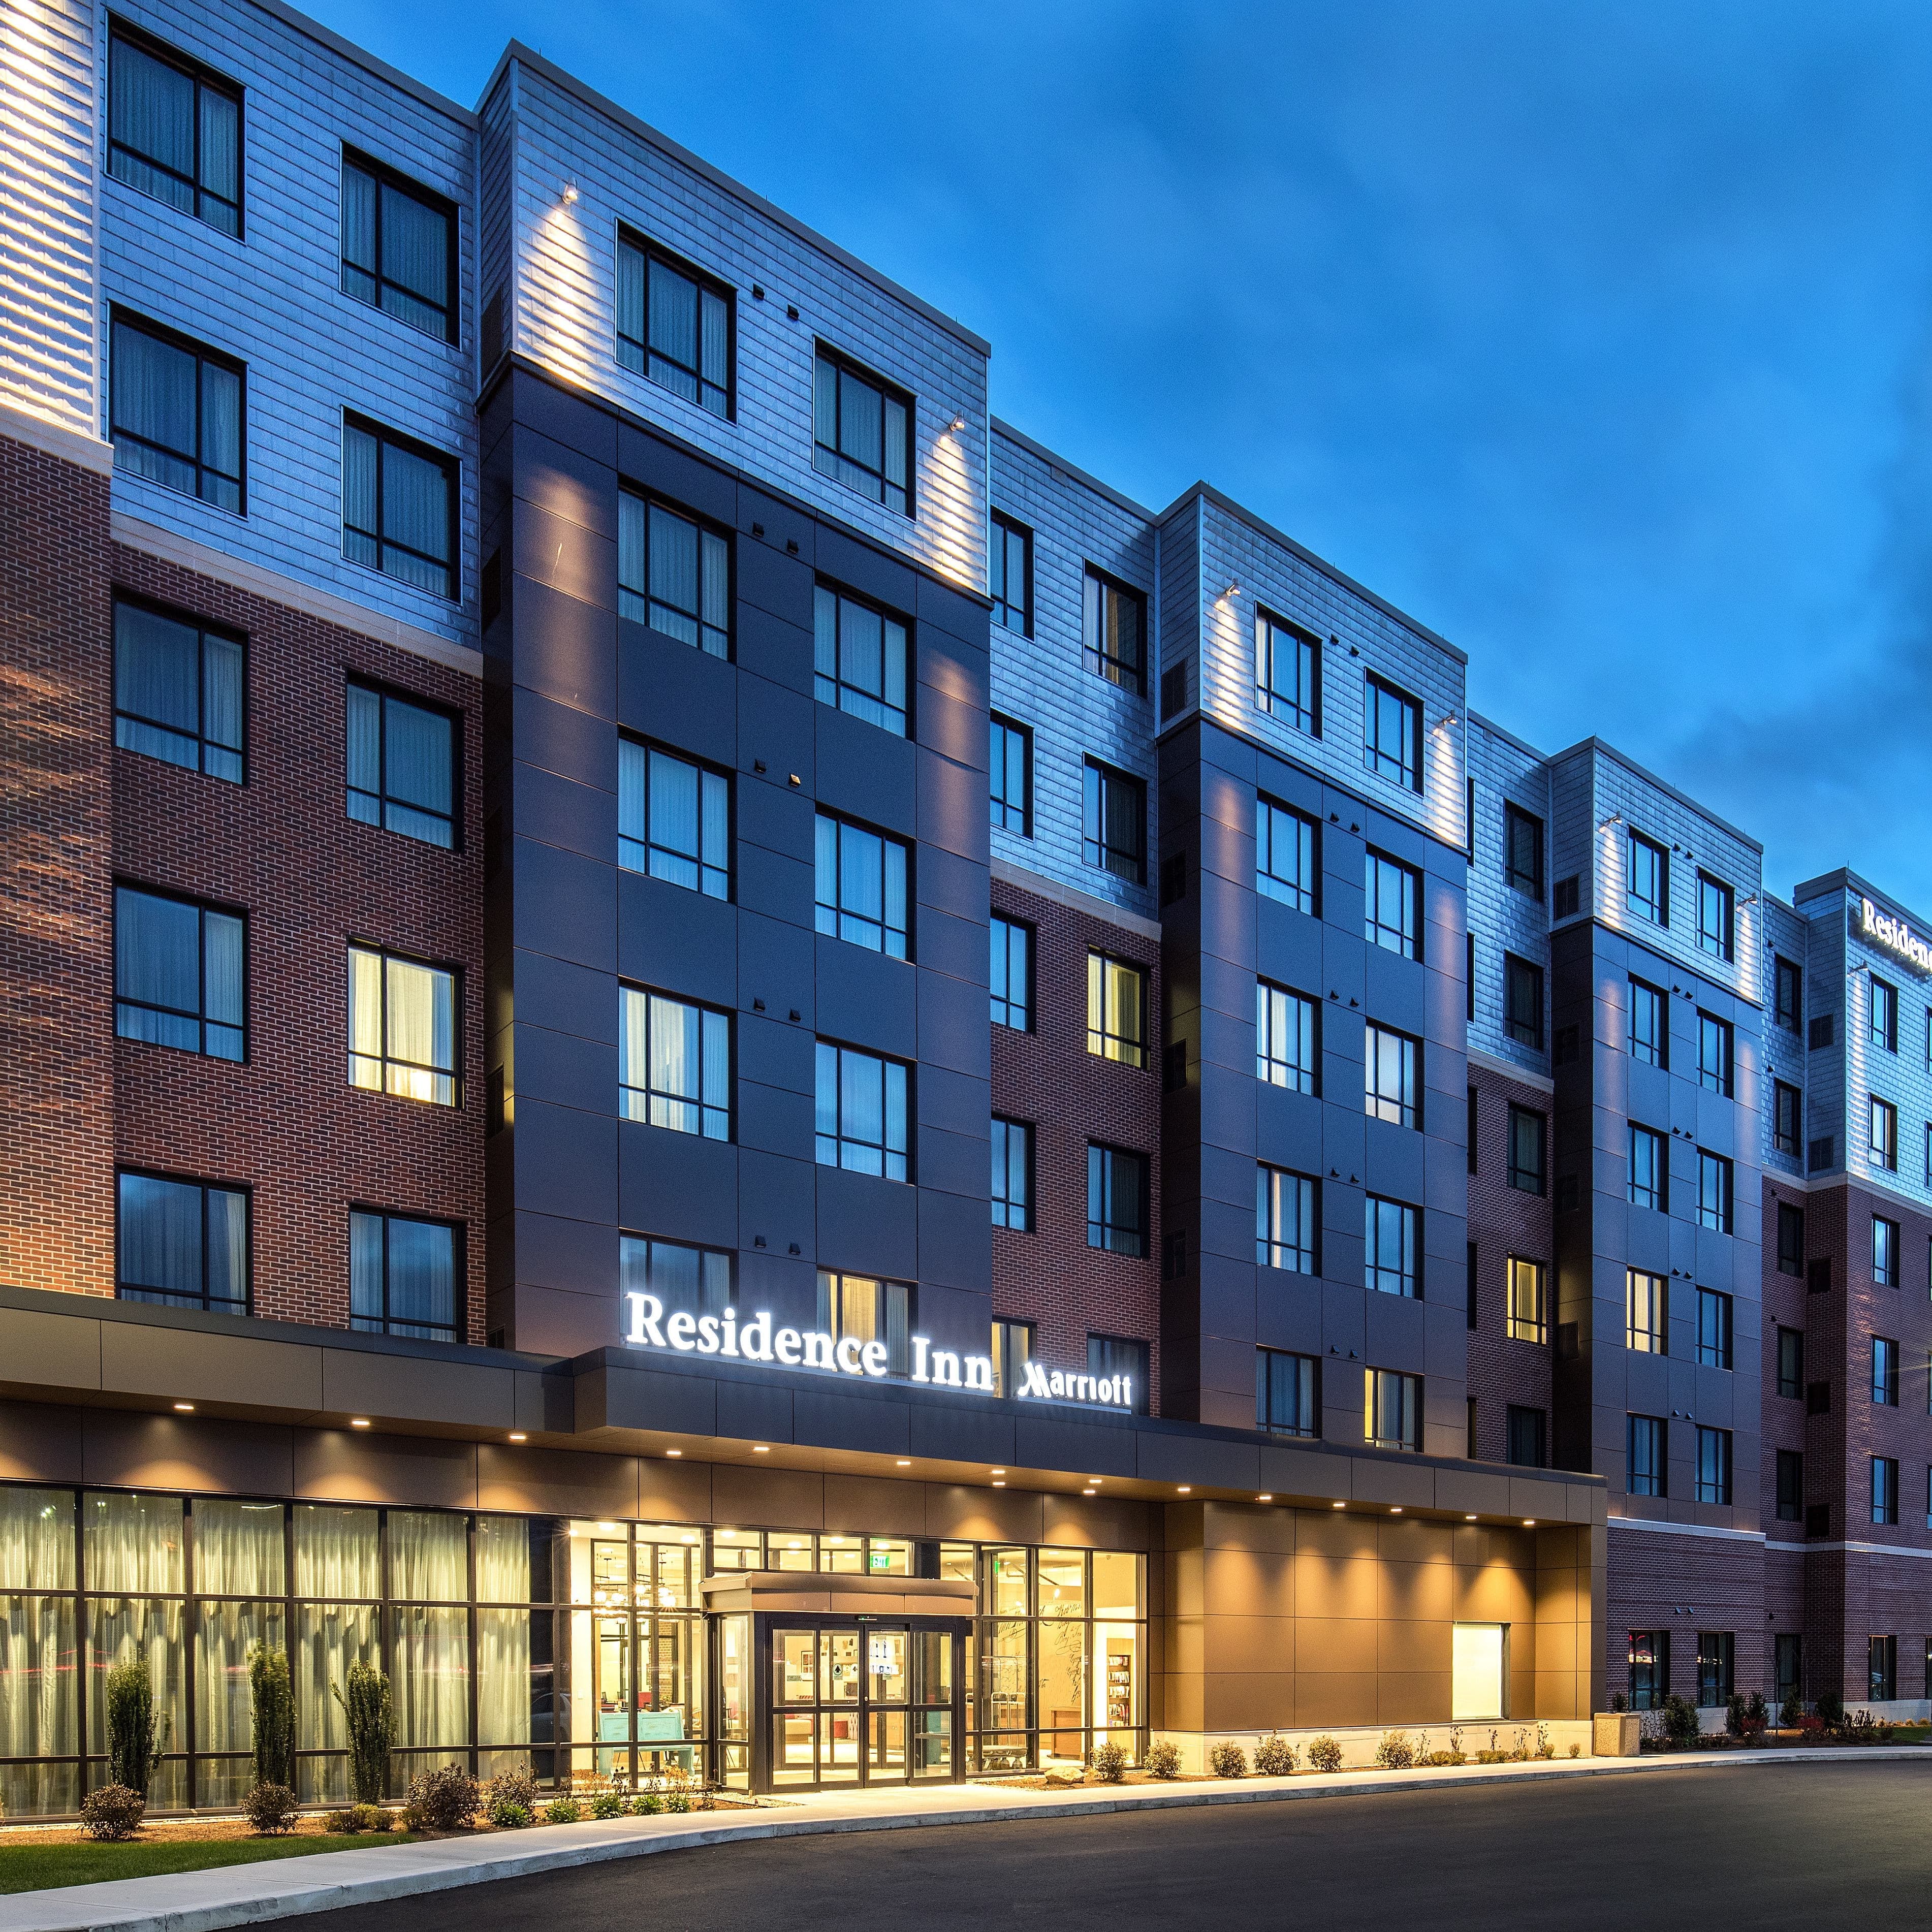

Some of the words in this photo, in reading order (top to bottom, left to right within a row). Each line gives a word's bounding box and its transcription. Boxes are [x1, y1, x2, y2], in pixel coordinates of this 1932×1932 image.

[624, 1291, 887, 1376] Residence
[912, 1337, 994, 1390] Inn
[1017, 1361, 1131, 1405] Marriott
